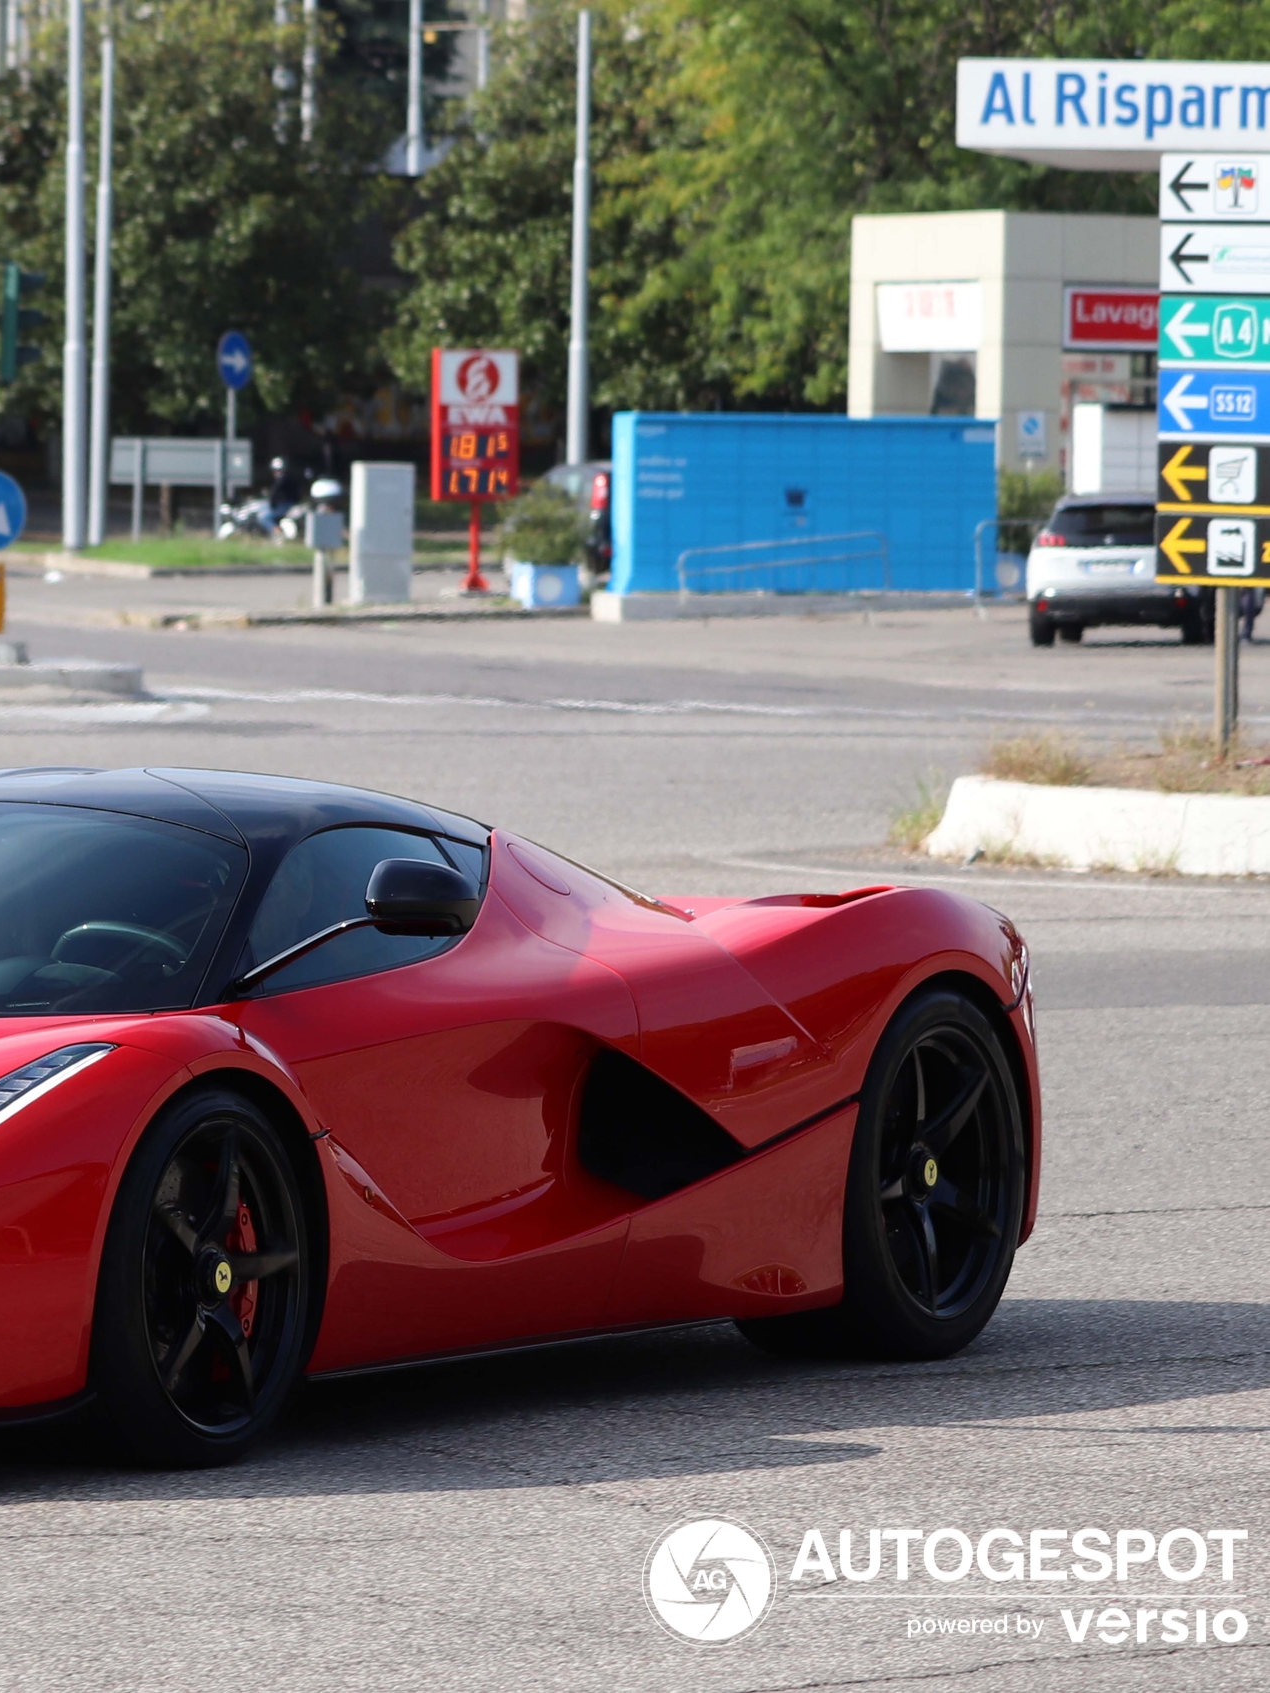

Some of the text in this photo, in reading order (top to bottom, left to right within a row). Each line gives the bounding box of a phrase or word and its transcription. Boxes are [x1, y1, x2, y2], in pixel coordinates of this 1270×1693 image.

[980, 72, 1036, 125] Al
[1075, 298, 1160, 330] Lavag
[1219, 316, 1252, 345] A4
[447, 406, 508, 426] EWA
[1215, 393, 1252, 414] SS12
